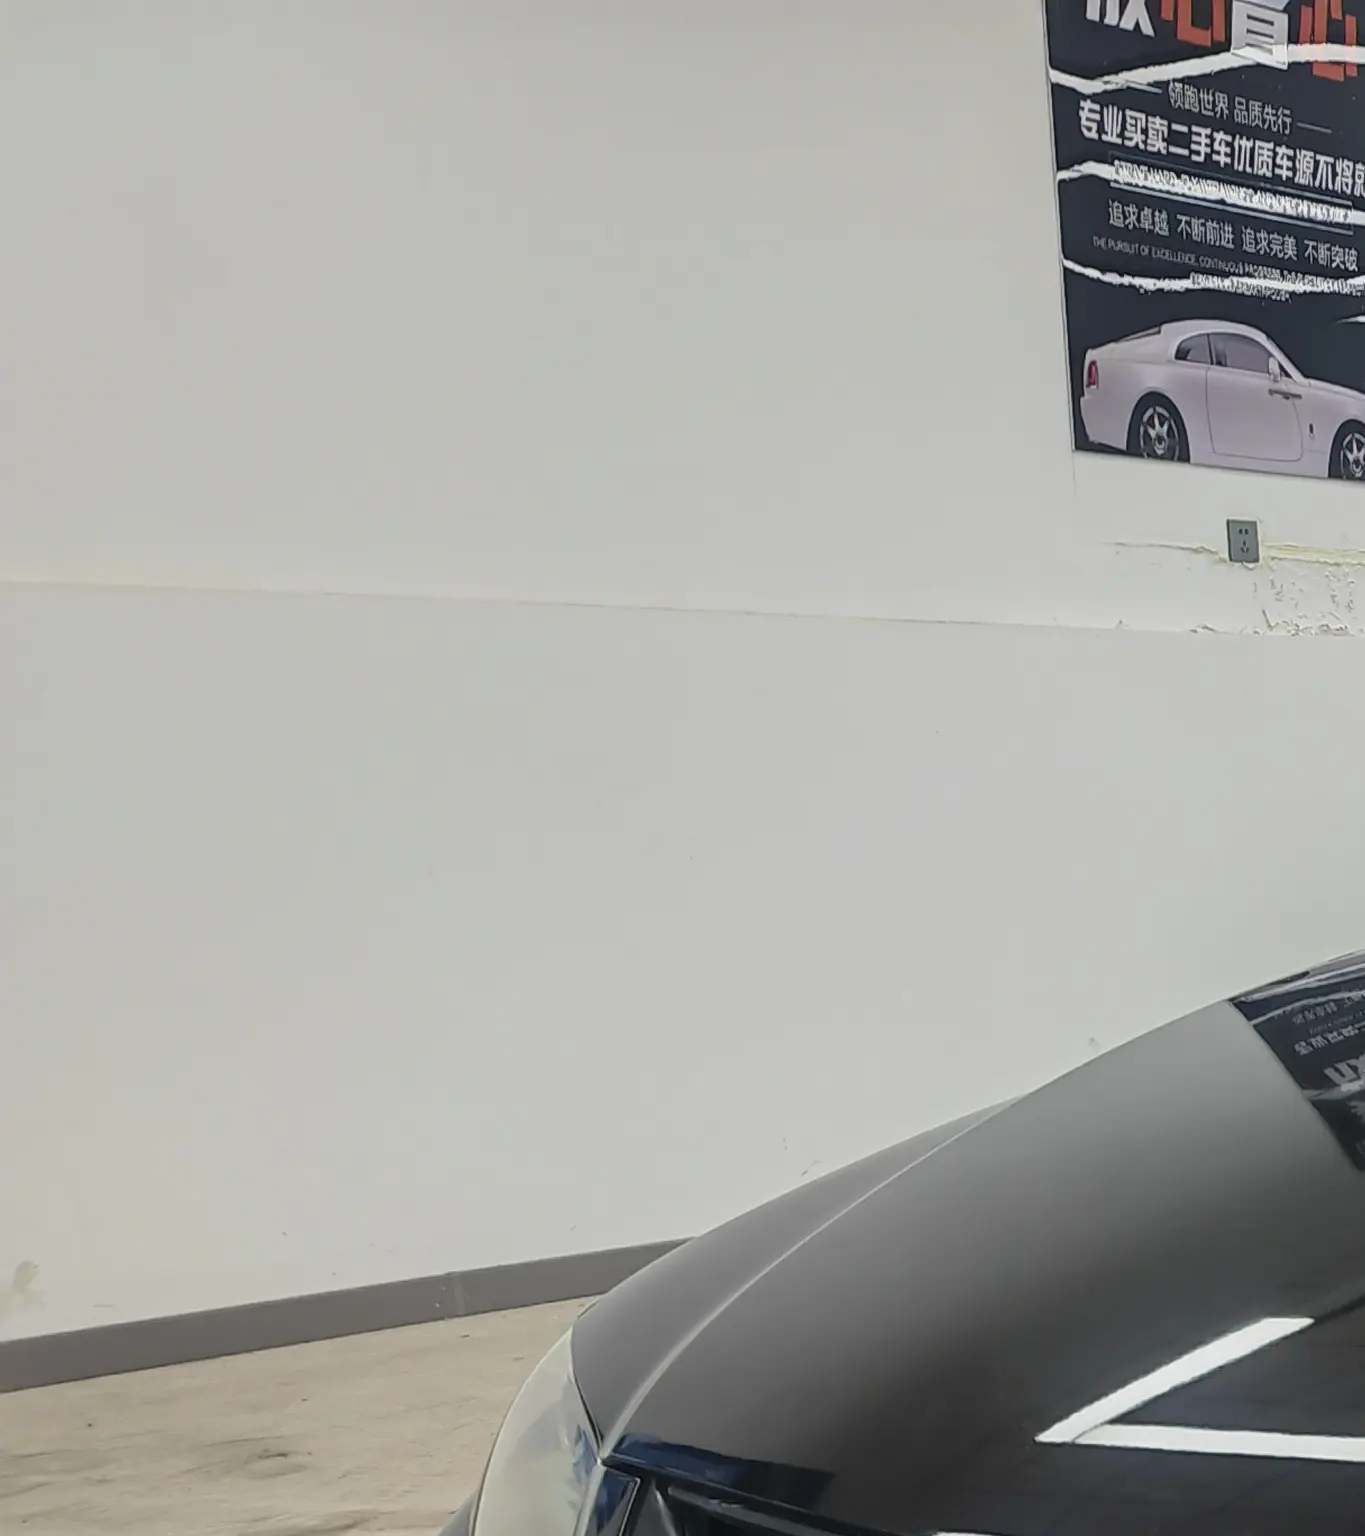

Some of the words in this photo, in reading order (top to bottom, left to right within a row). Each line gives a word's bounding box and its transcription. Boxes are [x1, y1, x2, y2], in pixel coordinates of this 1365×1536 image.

[1168, 79, 1230, 120] 领跑世界
[1233, 95, 1293, 135] 品质先行
[1108, 199, 1170, 237] 追求卓越
[1176, 213, 1235, 250] 不断前进
[1241, 226, 1298, 262] 追求完美
[1303, 239, 1359, 273] 不断突破
